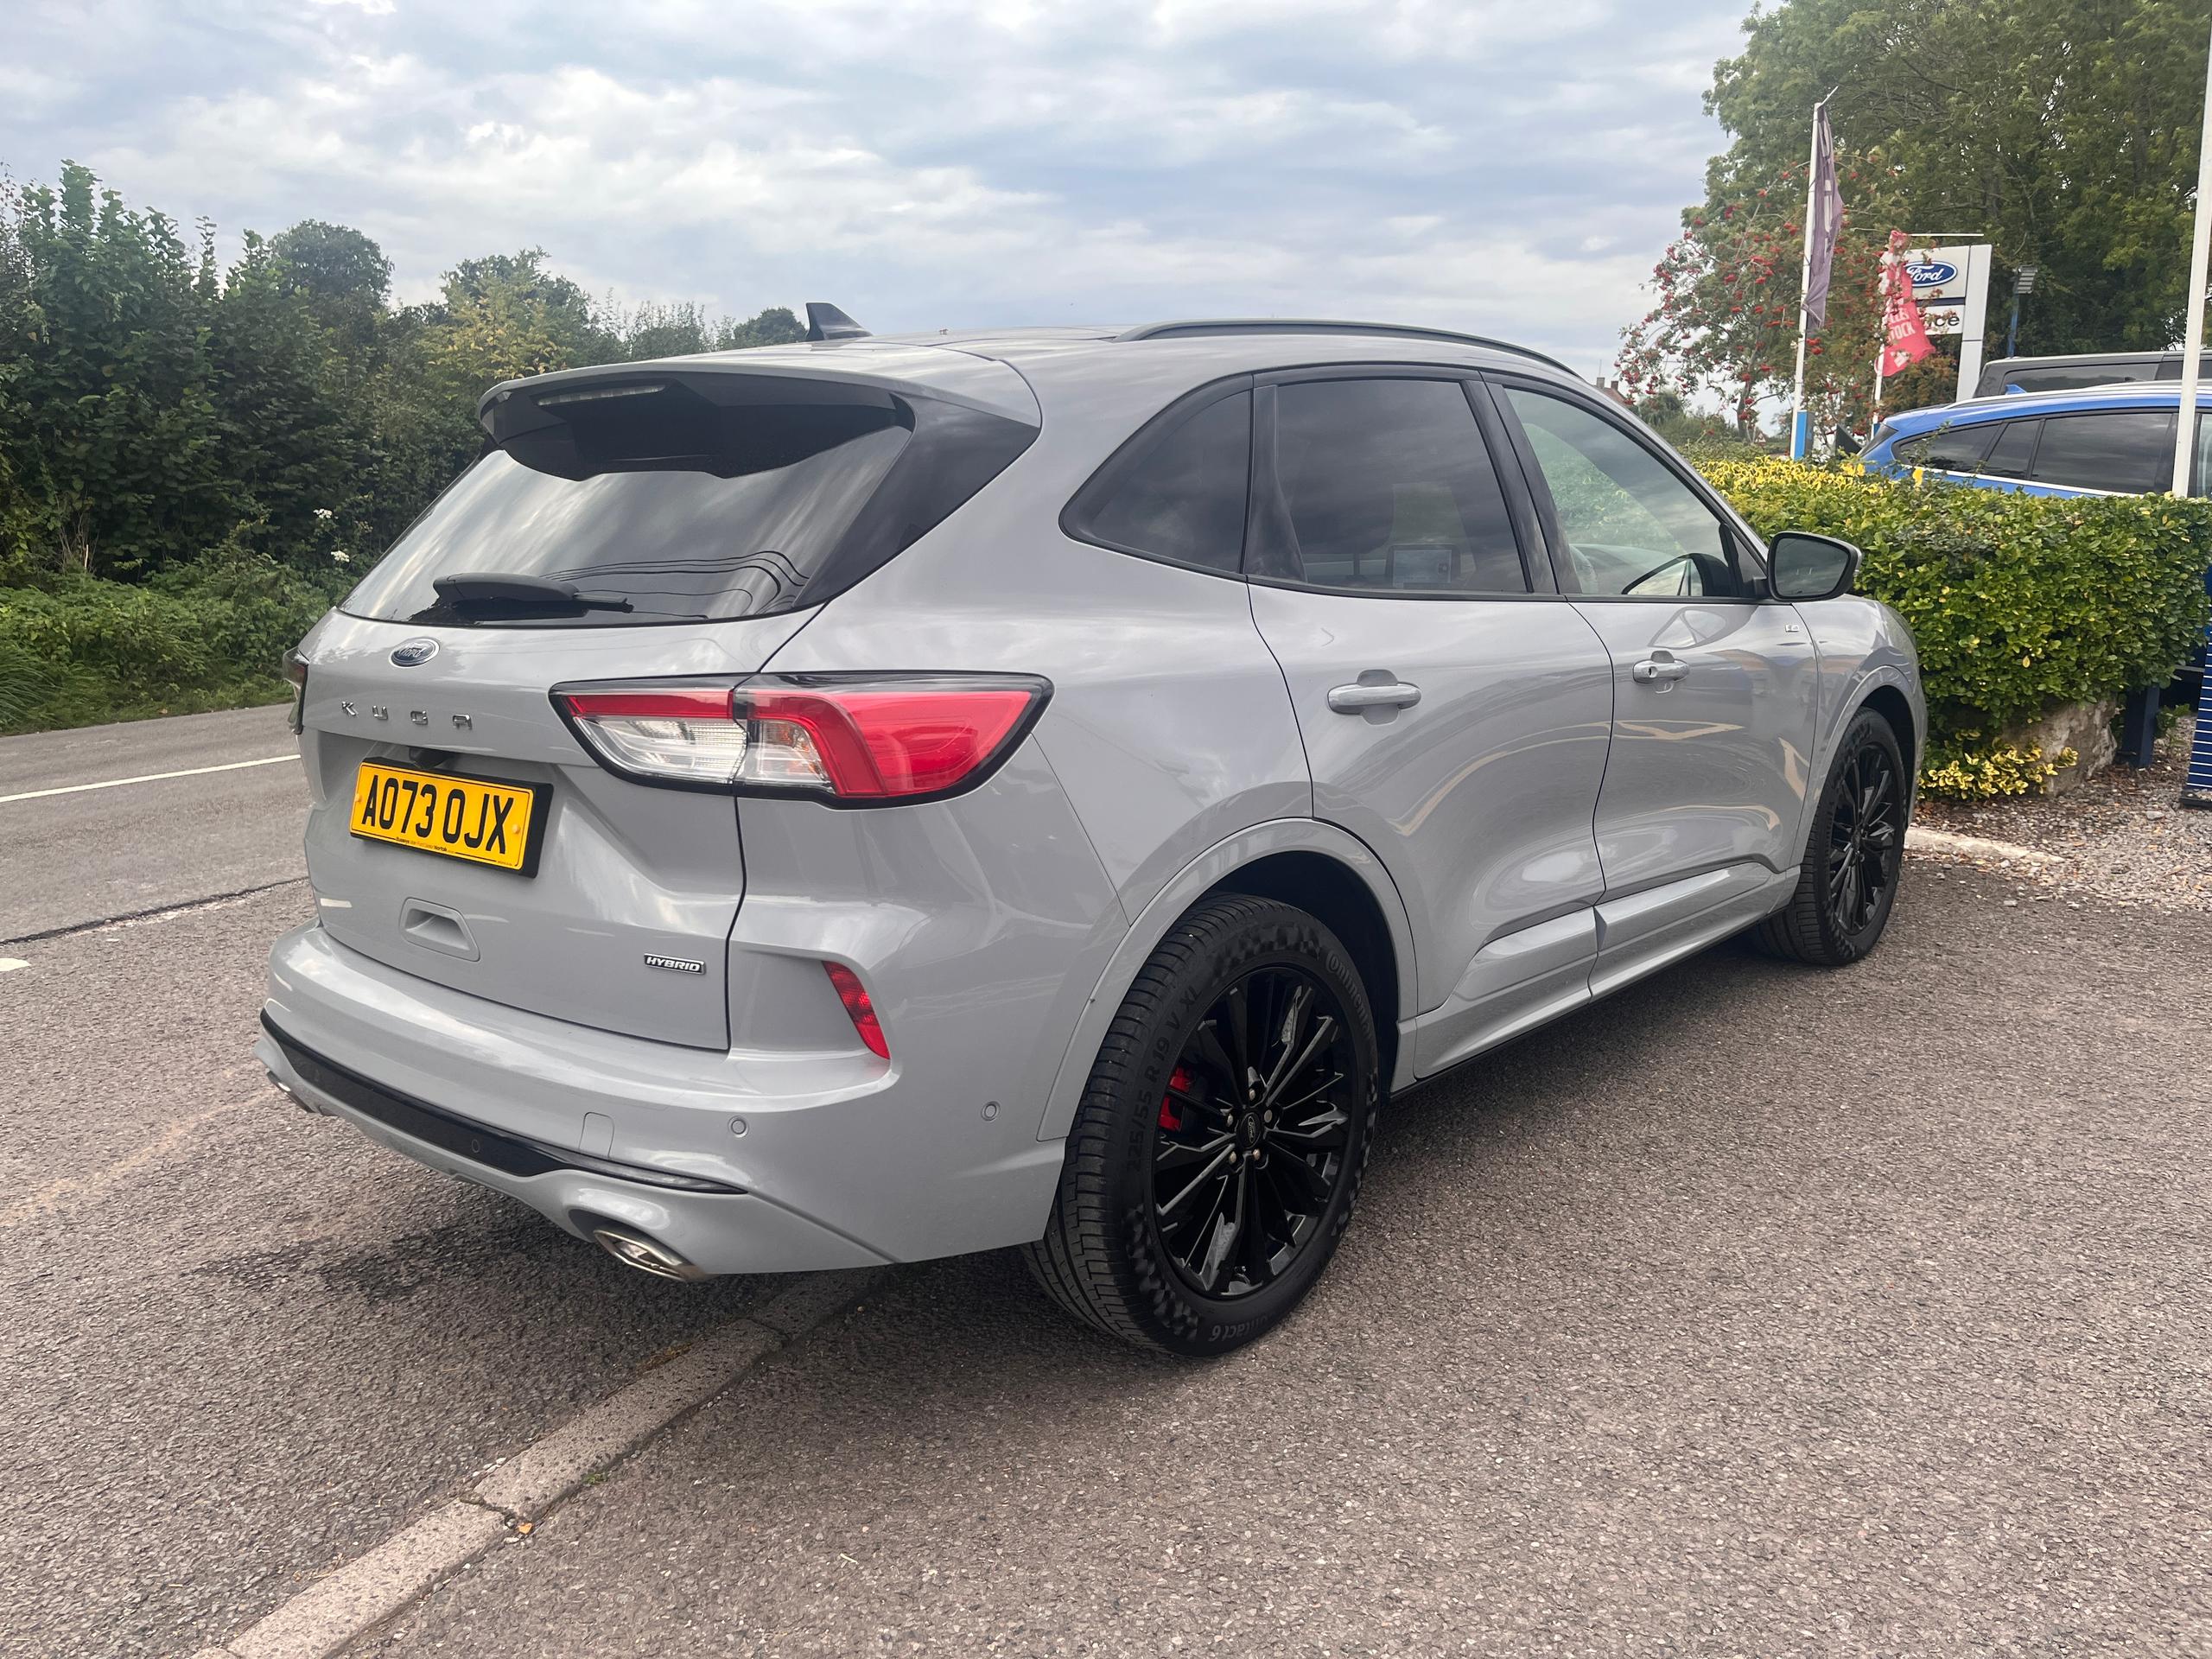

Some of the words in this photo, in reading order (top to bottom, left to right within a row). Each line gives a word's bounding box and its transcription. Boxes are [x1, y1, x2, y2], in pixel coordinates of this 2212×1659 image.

[1906, 265, 1944, 282] Ford
[341, 701, 473, 729] KUGA
[646, 957, 701, 972] HYBRID
[1326, 951, 1371, 1039] Continenta
[1152, 1038, 1170, 1060] 19
